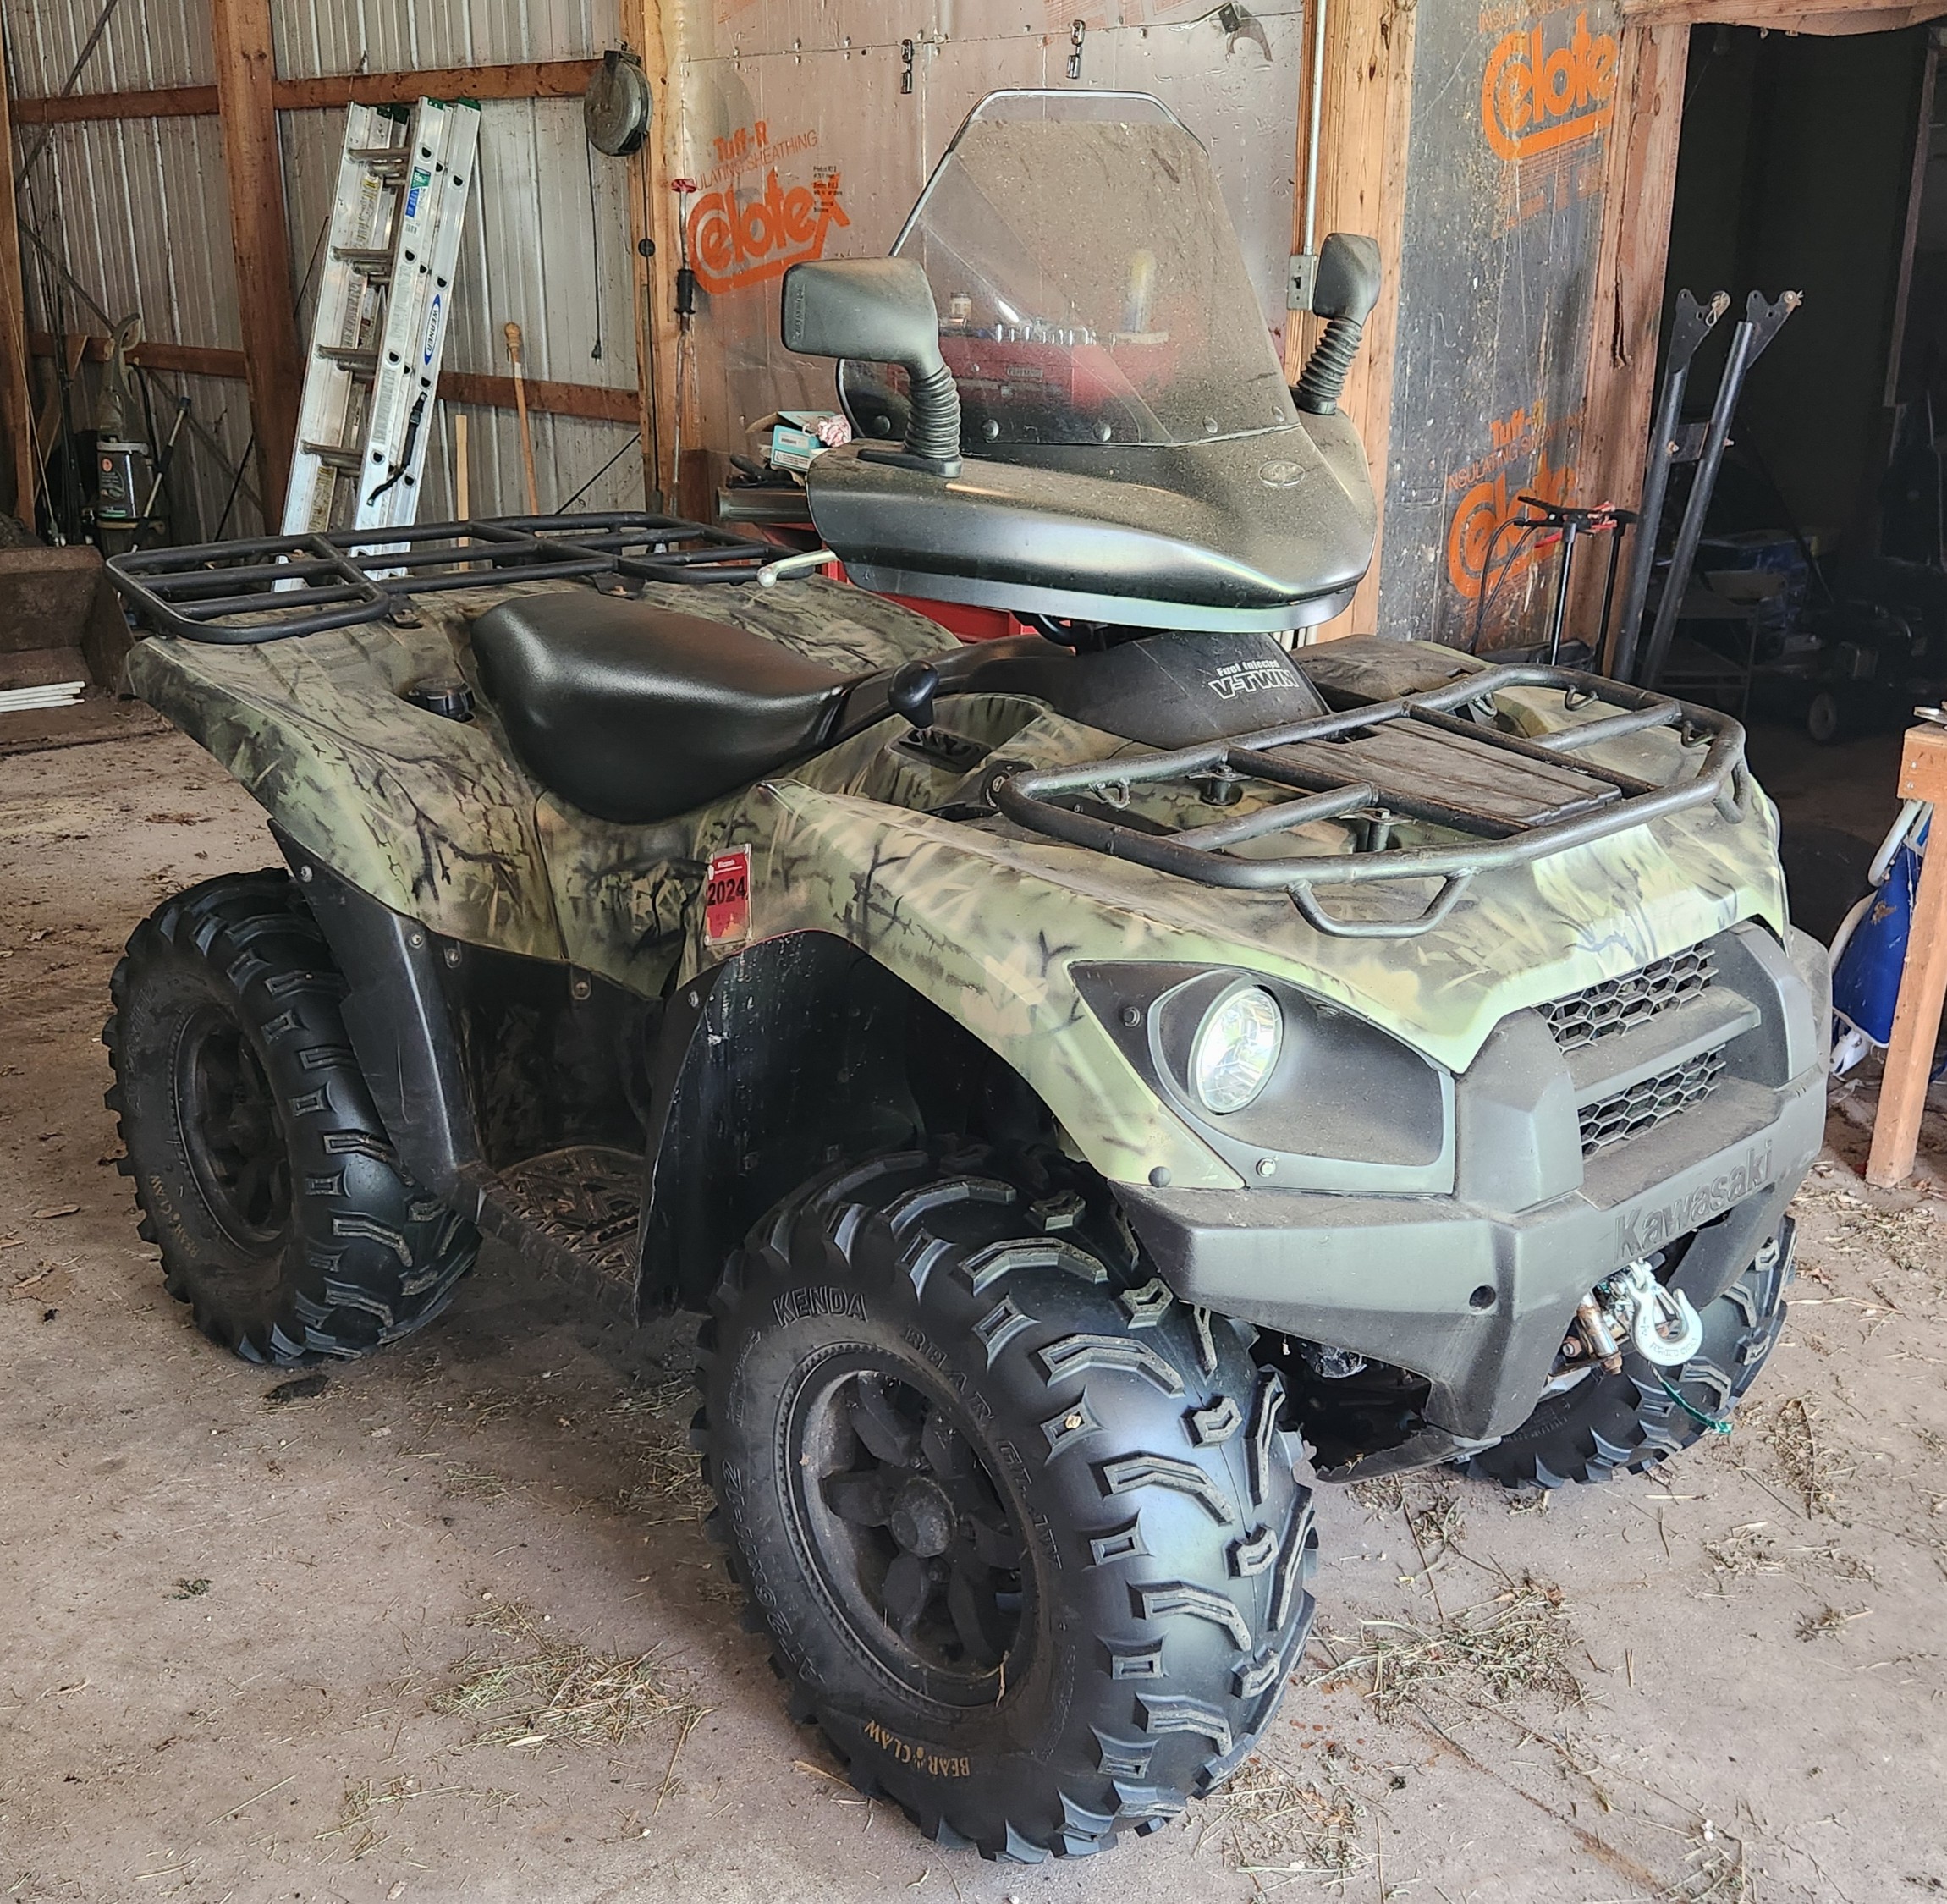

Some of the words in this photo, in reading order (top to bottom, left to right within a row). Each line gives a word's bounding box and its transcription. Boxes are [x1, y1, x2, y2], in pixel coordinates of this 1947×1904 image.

[1482, 8, 1619, 161] Celote
[687, 167, 850, 294] Celotex
[426, 309, 438, 352] WERNER
[1208, 669, 1301, 700] V-TWIN
[1216, 663, 1241, 677] Fuel
[1242, 660, 1281, 671] Injected
[707, 876, 747, 906] 2024
[1614, 1139, 1772, 1264] Kawasaki
[773, 1285, 869, 1329] KENDA
[863, 1719, 912, 1764] CLAW
[927, 1754, 971, 1778] BEAR
